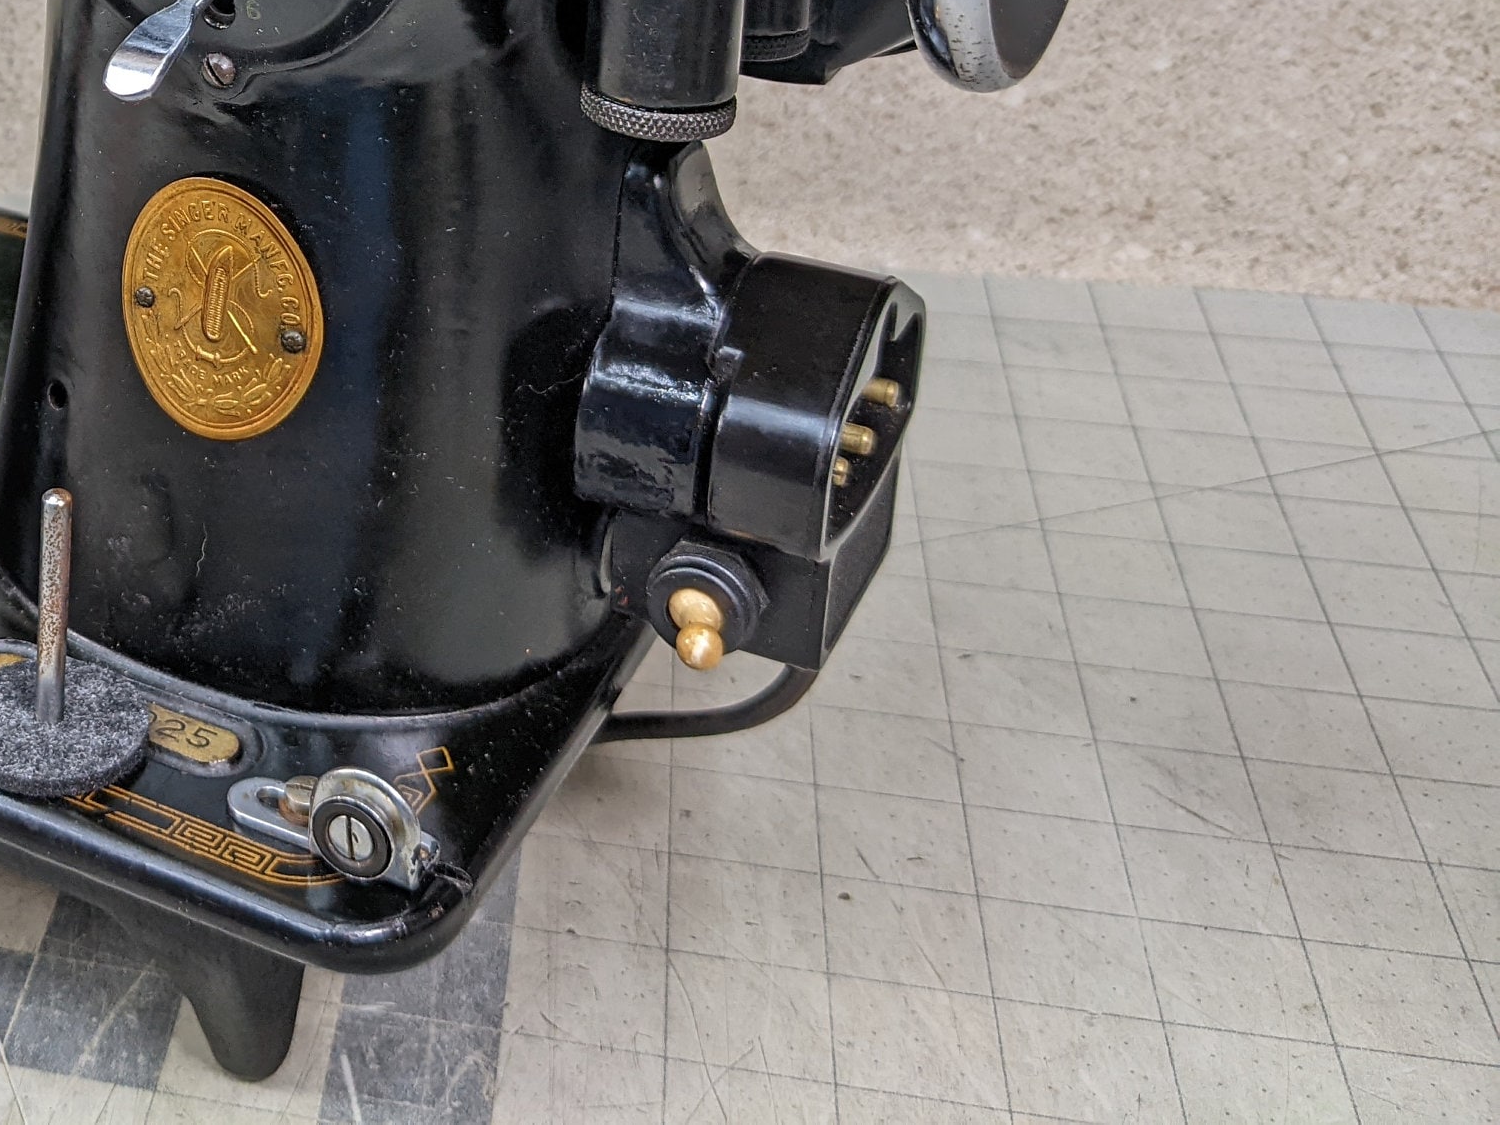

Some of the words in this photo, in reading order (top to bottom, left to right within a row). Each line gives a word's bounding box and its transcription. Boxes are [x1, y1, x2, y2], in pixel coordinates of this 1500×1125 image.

[246, 0, 261, 20] 6
[143, 237, 169, 281] THE
[160, 199, 230, 241] SINGER
[174, 339, 206, 380] TRADE
[212, 365, 249, 383] MARK
